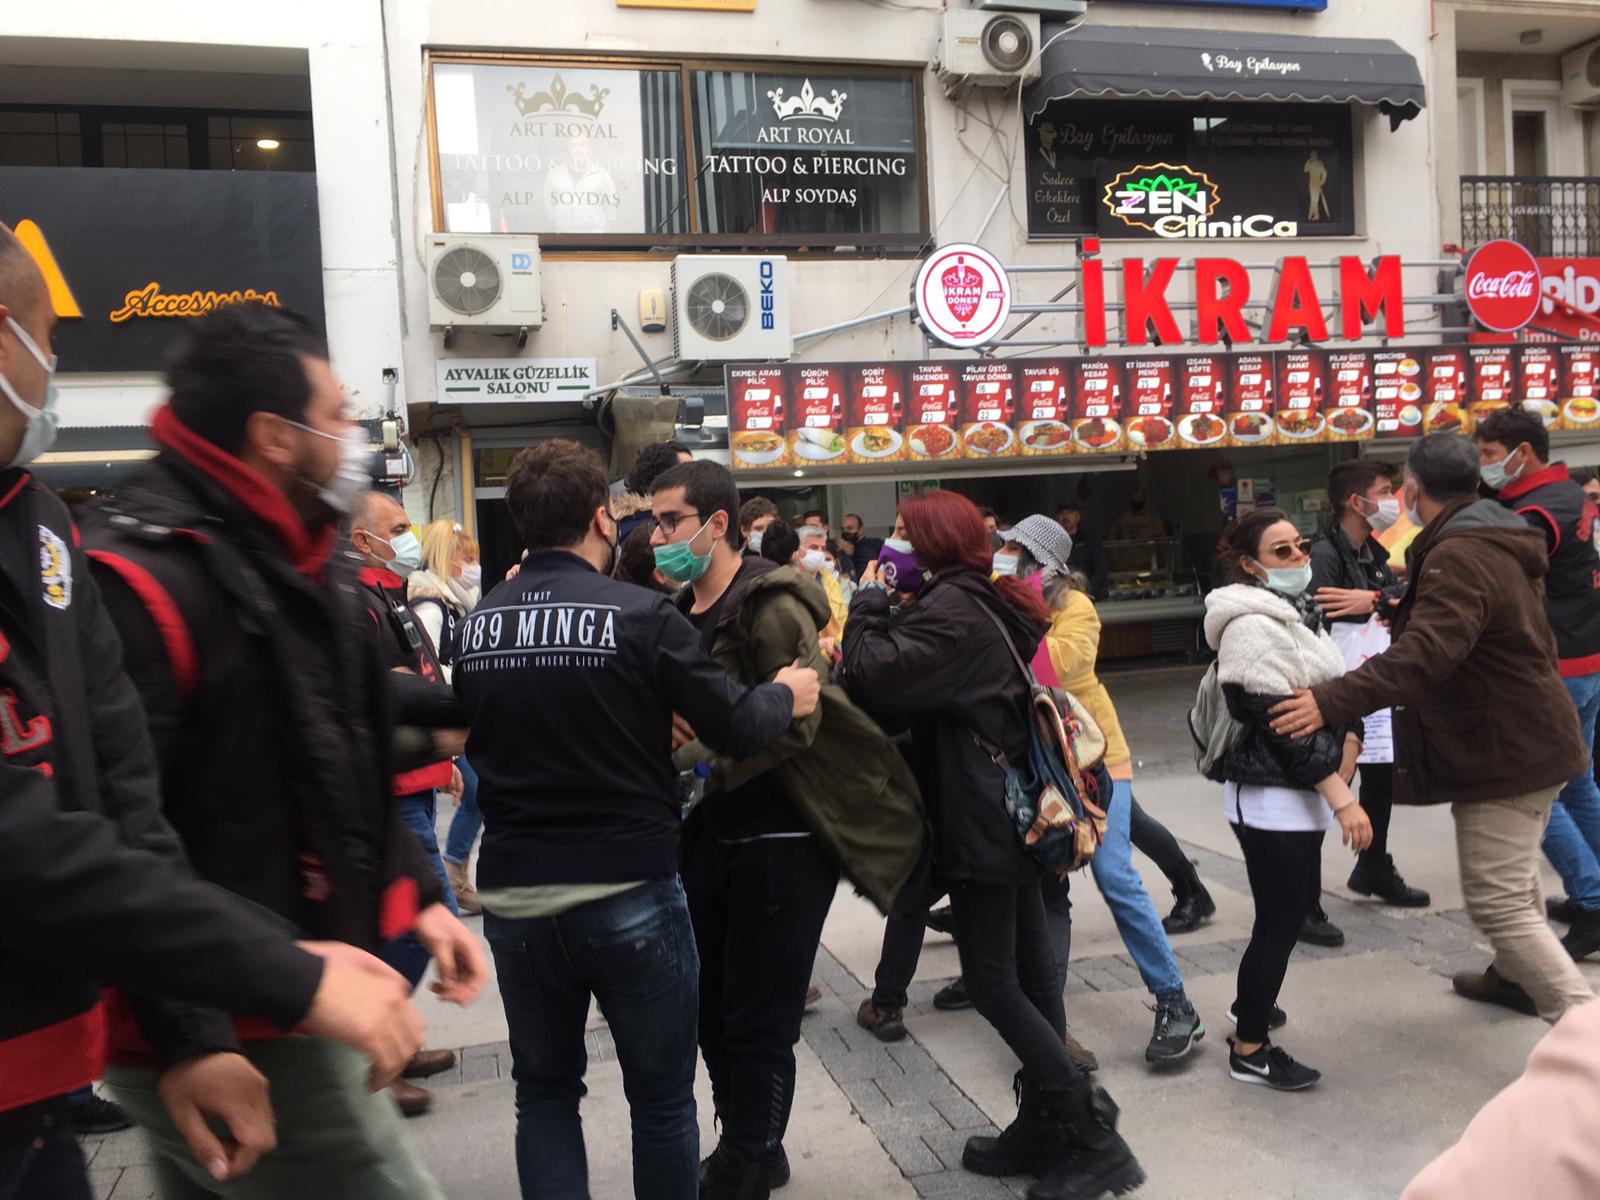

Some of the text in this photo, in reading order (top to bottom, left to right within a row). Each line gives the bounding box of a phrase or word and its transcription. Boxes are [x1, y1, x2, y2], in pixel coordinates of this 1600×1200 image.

[1215, 54, 1301, 75] Bay Epilasyon
[510, 122, 618, 139] ART ROYAL
[756, 127, 855, 144] ART ROYAL
[1059, 123, 1095, 151] Bay
[454, 153, 541, 171] TATTOO
[706, 155, 906, 176] TATTOO & PIERCING
[500, 191, 621, 210] ALP SOYDAŞ
[762, 188, 857, 207] ALP SOYDAŞ
[1115, 191, 1206, 214] ZEN
[1154, 214, 1298, 238] CliniCa
[1469, 270, 1536, 299] Coca-Cola
[760, 261, 774, 330] BEKO
[1081, 238, 1405, 348] İKRAM
[1081, 362, 1108, 370] MANİSA
[1126, 360, 1169, 369] ET İSKENDER
[1238, 356, 1262, 364] ADANA
[1341, 361, 1364, 369] DÖNER
[445, 364, 589, 380] AYVALIK GÜZELLİK
[758, 369, 781, 377] ARASI
[801, 368, 829, 377] DÜRÜM
[966, 364, 1007, 373] PİLAV ÜSTÜ
[1024, 367, 1059, 376] TAVUK ŞİŞ
[1084, 370, 1107, 378] KEBAP
[1138, 368, 1158, 376] MENÜ
[1188, 365, 1211, 373] KÖFTE
[747, 376, 766, 385] PİLİÇ
[805, 376, 825, 386] PİLİÇ
[864, 375, 884, 385] PİLİÇ
[913, 373, 949, 381] İSKENDER
[987, 373, 1012, 381] DÖNER
[487, 381, 550, 394] SALONU
[462, 612, 503, 653] 089
[515, 608, 617, 648] MINGA
[535, 655, 570, 667] UNSERE
